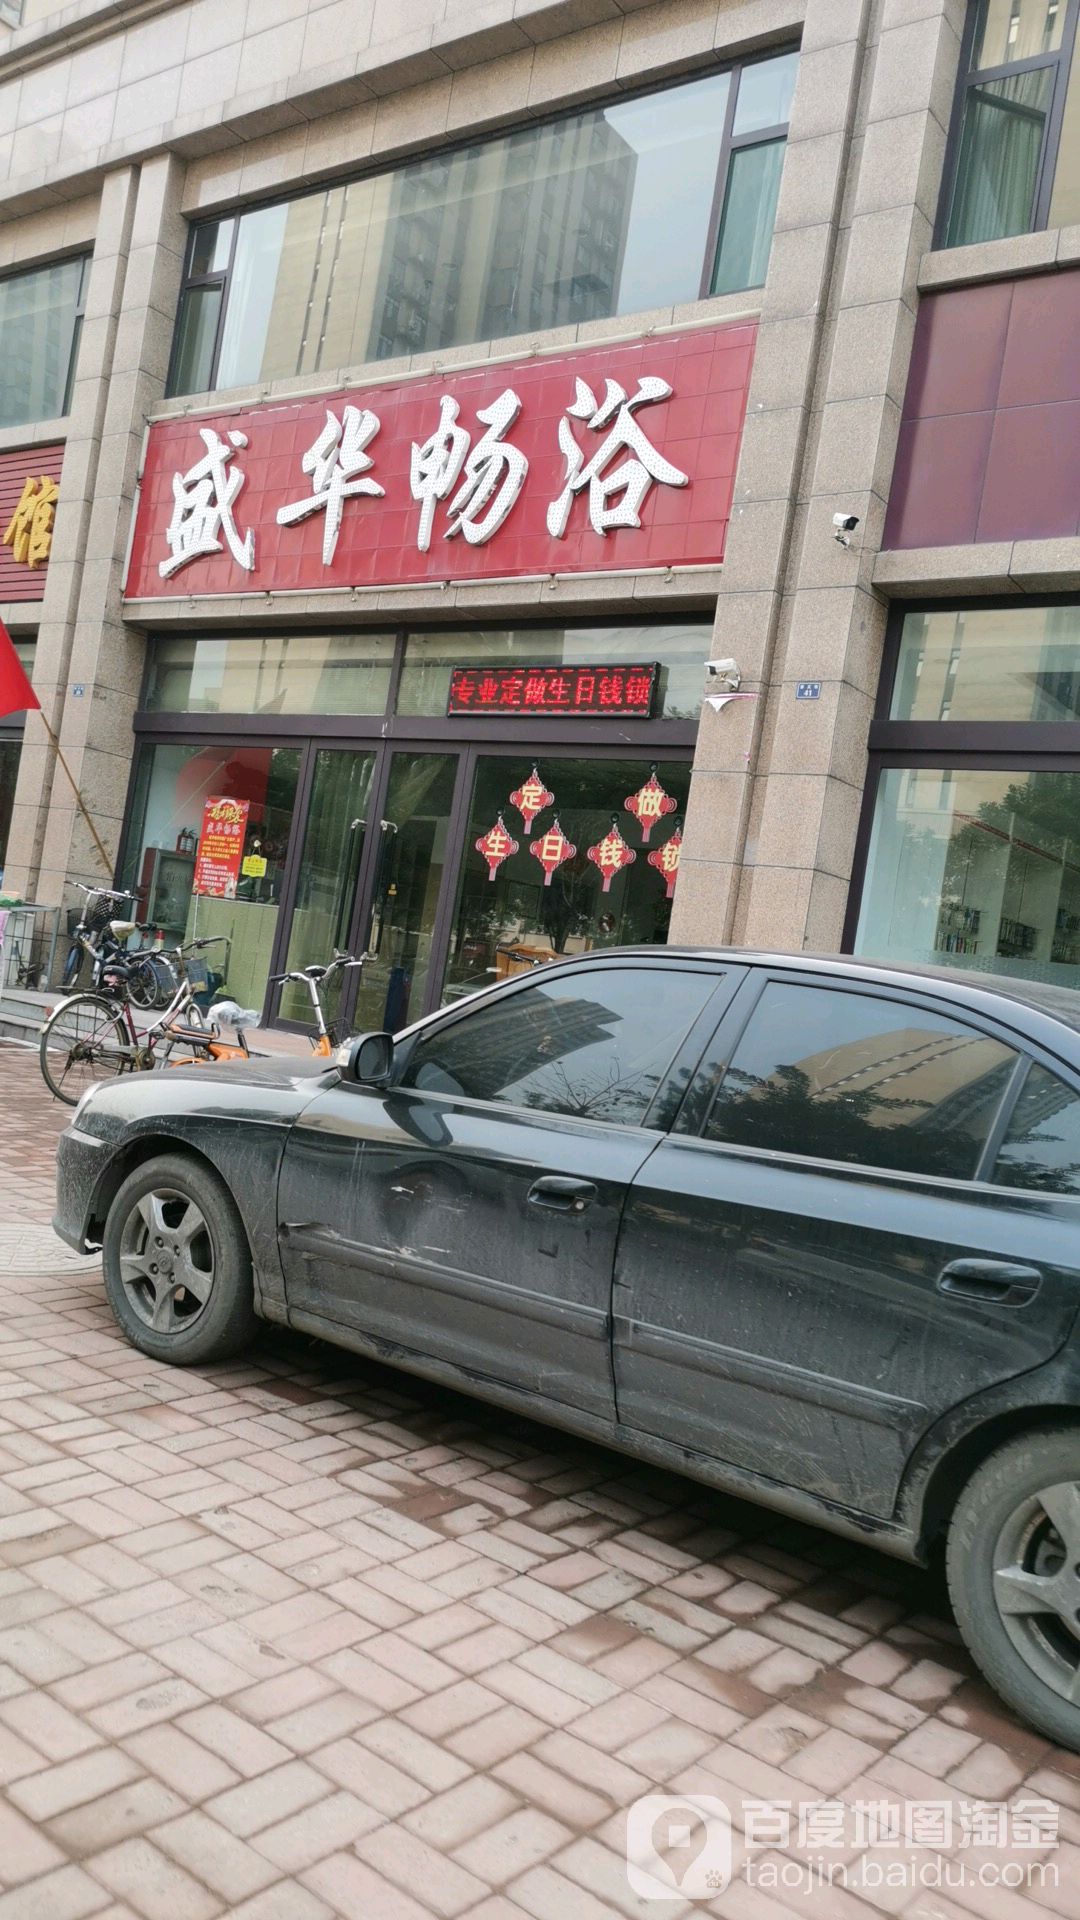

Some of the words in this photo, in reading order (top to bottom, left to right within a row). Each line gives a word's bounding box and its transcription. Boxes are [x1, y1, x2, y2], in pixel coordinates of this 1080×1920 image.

[158, 376, 689, 580] 盛华畅浴
[453, 676, 650, 705] 专业定做生日钱锁
